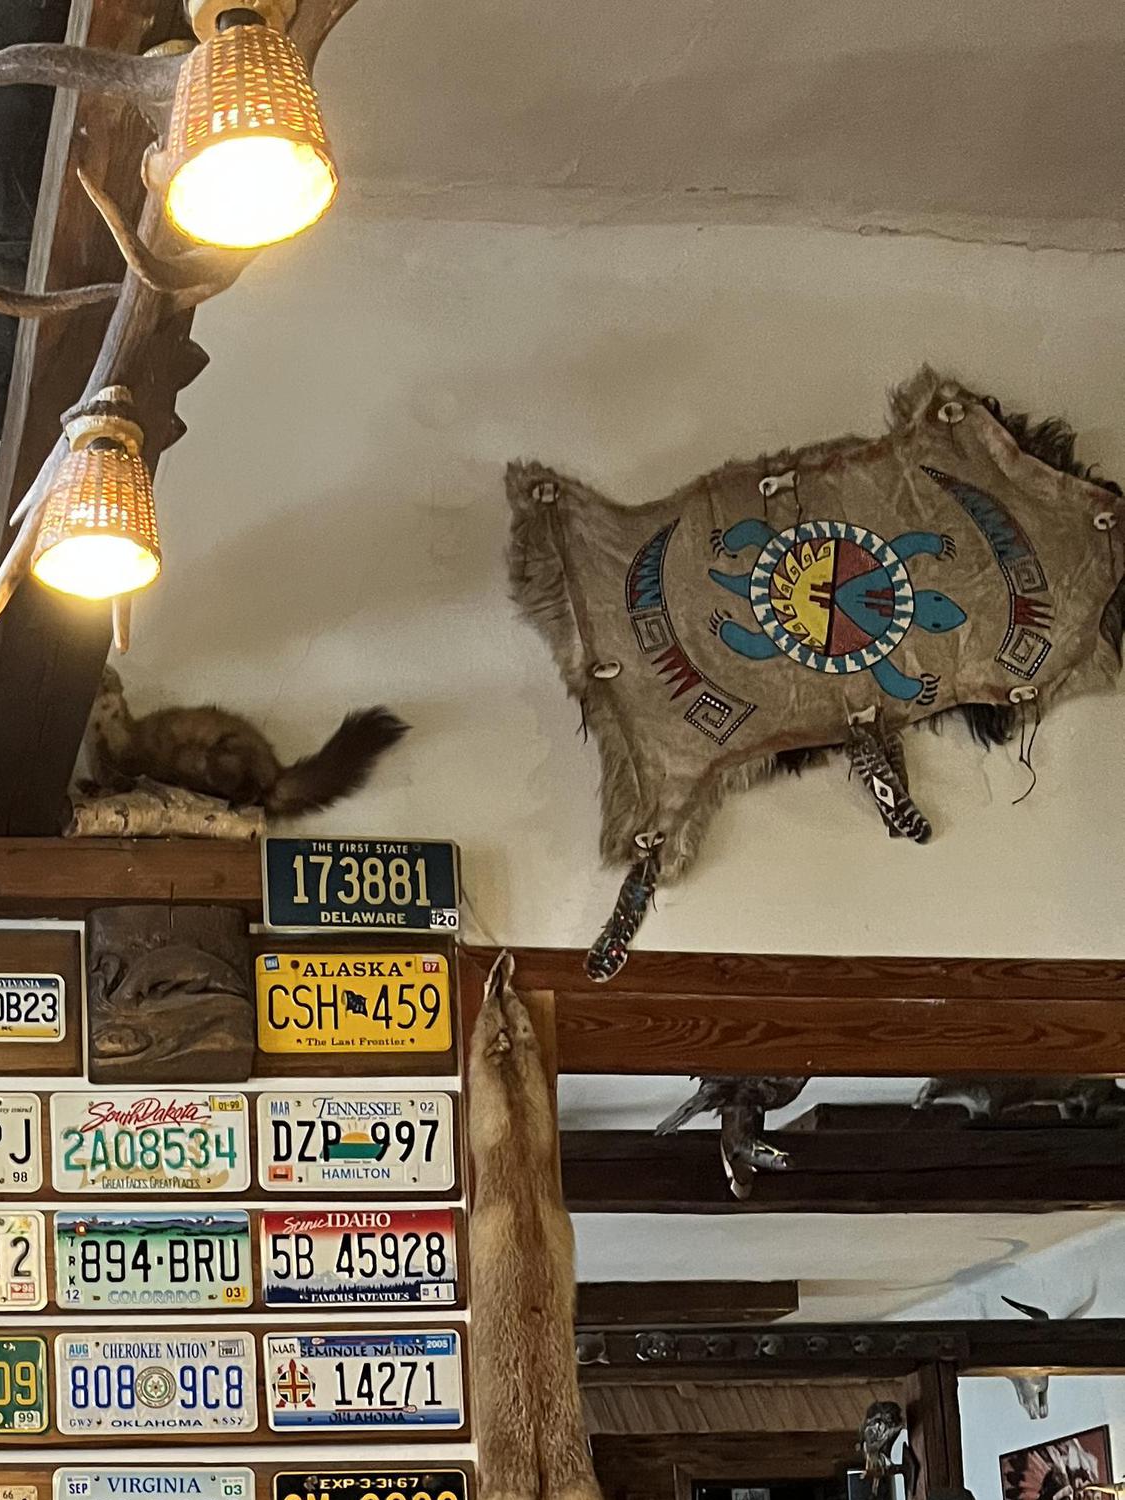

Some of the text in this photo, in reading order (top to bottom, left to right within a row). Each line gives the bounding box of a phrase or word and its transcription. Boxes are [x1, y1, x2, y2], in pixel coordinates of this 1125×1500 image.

[312, 842, 409, 855] THE FIRST STATE
[292, 855, 432, 907] 173881
[320, 911, 407, 925] DELAWARE
[302, 961, 404, 978] ALASKA
[424, 962, 438, 972] 97
[267, 983, 441, 1030] CSH 459
[305, 1037, 406, 1046] The Last Frontier
[270, 1101, 290, 1115] MAR
[420, 1102, 435, 1112] 02
[12, 1172, 28, 1183] 98
[321, 1167, 391, 1179] HAMILTON
[282, 1212, 391, 1234] Scenic IDAHO
[271, 1231, 447, 1281] 5B 45928
[65, 1288, 80, 1300] 12
[107, 1289, 202, 1303] COLORADO
[225, 1287, 241, 1299] 03
[310, 1291, 410, 1303] FAMOUS POTATOES
[68, 1344, 90, 1356] AUG
[102, 1342, 208, 1359] CHEROKEE NATION
[272, 1344, 297, 1356] MAR
[426, 1338, 449, 1350] 2005
[300, 1344, 426, 1358] SEMINOLE NATION
[70, 1364, 243, 1410] 808 9C8
[334, 1361, 443, 1407] 14271
[17, 1411, 35, 1424] 99
[110, 1419, 204, 1428] OKLAHOMA
[327, 1411, 406, 1424] OKLAHOMA
[68, 1482, 89, 1495] SEP
[107, 1476, 202, 1494] VIRGINIA
[223, 1485, 243, 1497] 03
